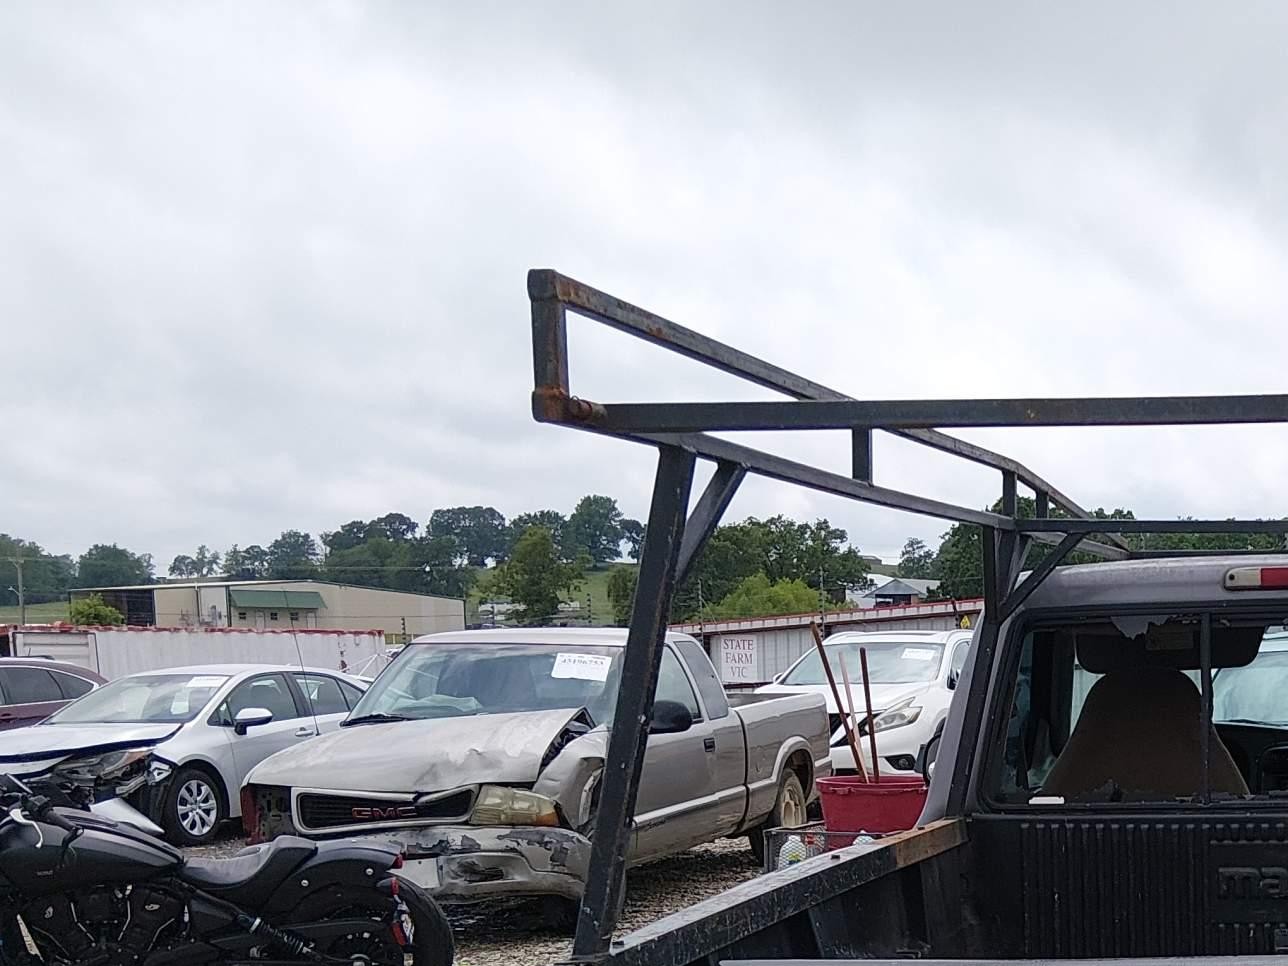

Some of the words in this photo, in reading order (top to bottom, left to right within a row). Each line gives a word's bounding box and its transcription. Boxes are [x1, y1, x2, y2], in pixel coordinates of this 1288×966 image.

[723, 639, 754, 650] STATE
[726, 652, 753, 665] FARM
[351, 806, 418, 820] GMC
